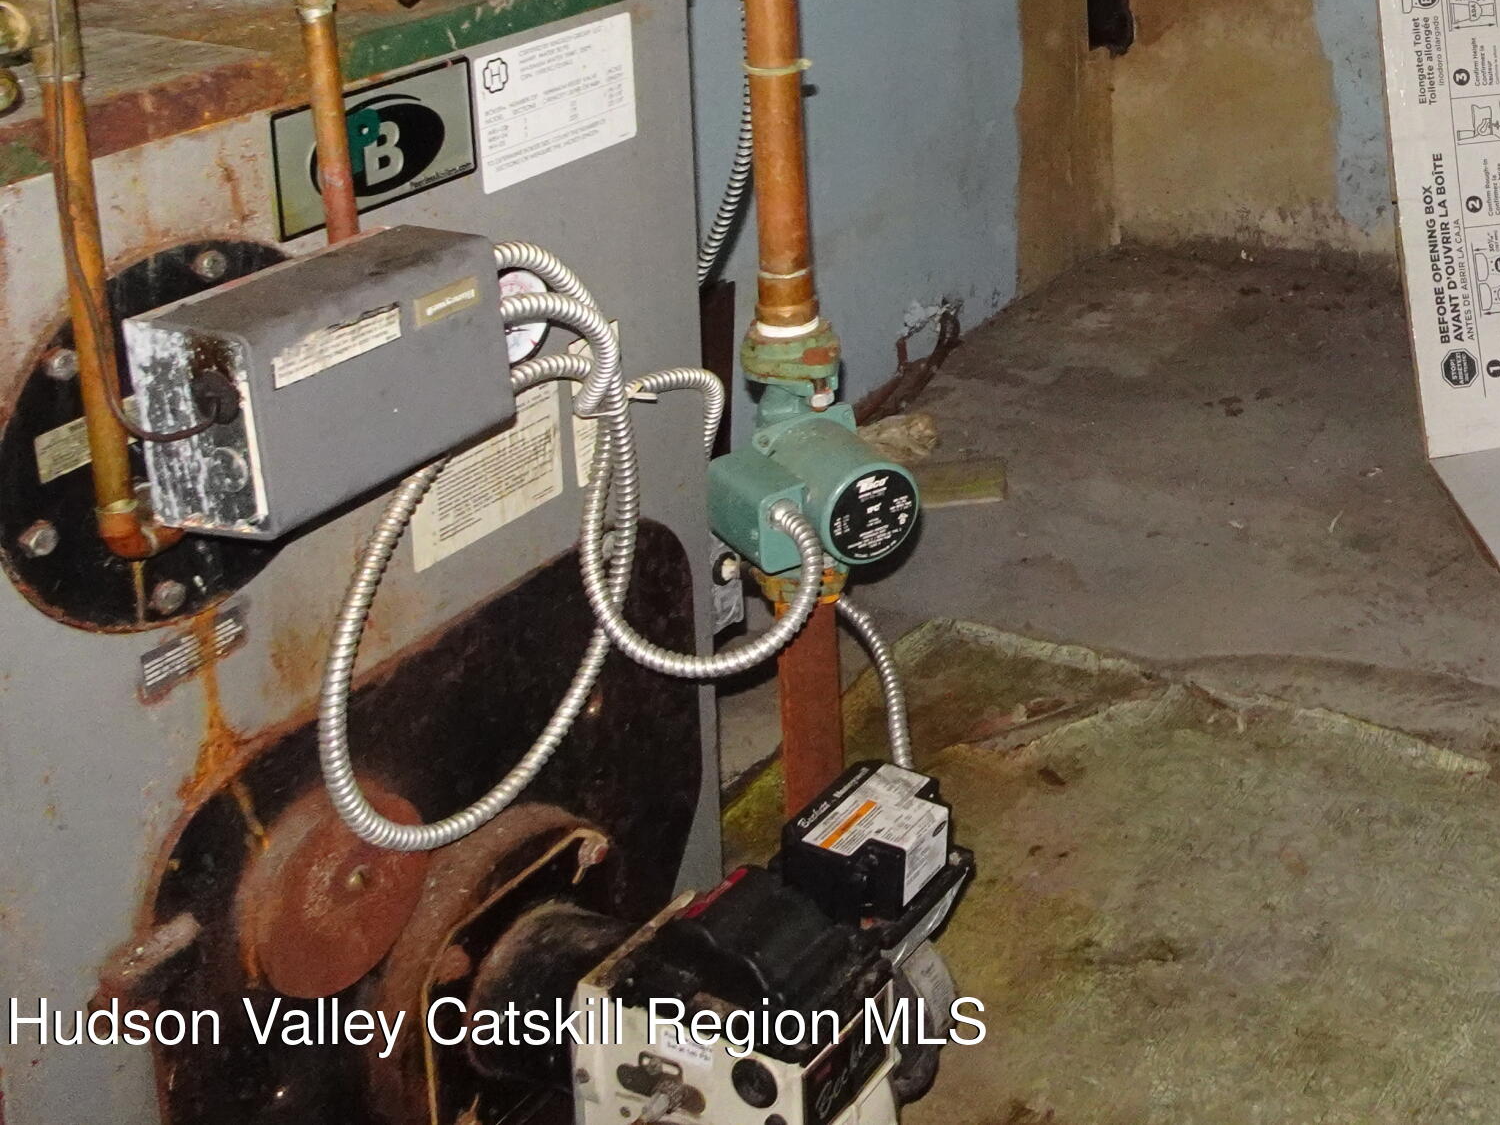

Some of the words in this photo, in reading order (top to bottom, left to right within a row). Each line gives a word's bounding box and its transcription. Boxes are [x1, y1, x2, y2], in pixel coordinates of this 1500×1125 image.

[1412, 16, 1422, 45] Toilet
[1421, 16, 1433, 61] allongée
[1433, 14, 1442, 51] alargado
[1415, 49, 1427, 103] Elongated
[1424, 64, 1438, 104] Toilette
[1436, 52, 1445, 85] Inodoro
[1431, 152, 1446, 195] BOÎTE
[1421, 184, 1434, 214] BOX
[1436, 198, 1449, 217] LA
[1486, 190, 1494, 215] Confirm
[1452, 217, 1462, 243] CAJA
[1426, 217, 1443, 282] OPENING
[1440, 221, 1458, 290] D'OUVRIR
[1456, 245, 1465, 258] LA
[1458, 260, 1469, 289] ABRIR
[1434, 286, 1451, 343] BEFORE
[1461, 292, 1471, 305] DE
[1448, 294, 1465, 342] AVANT
[1464, 308, 1475, 340] ANTES
